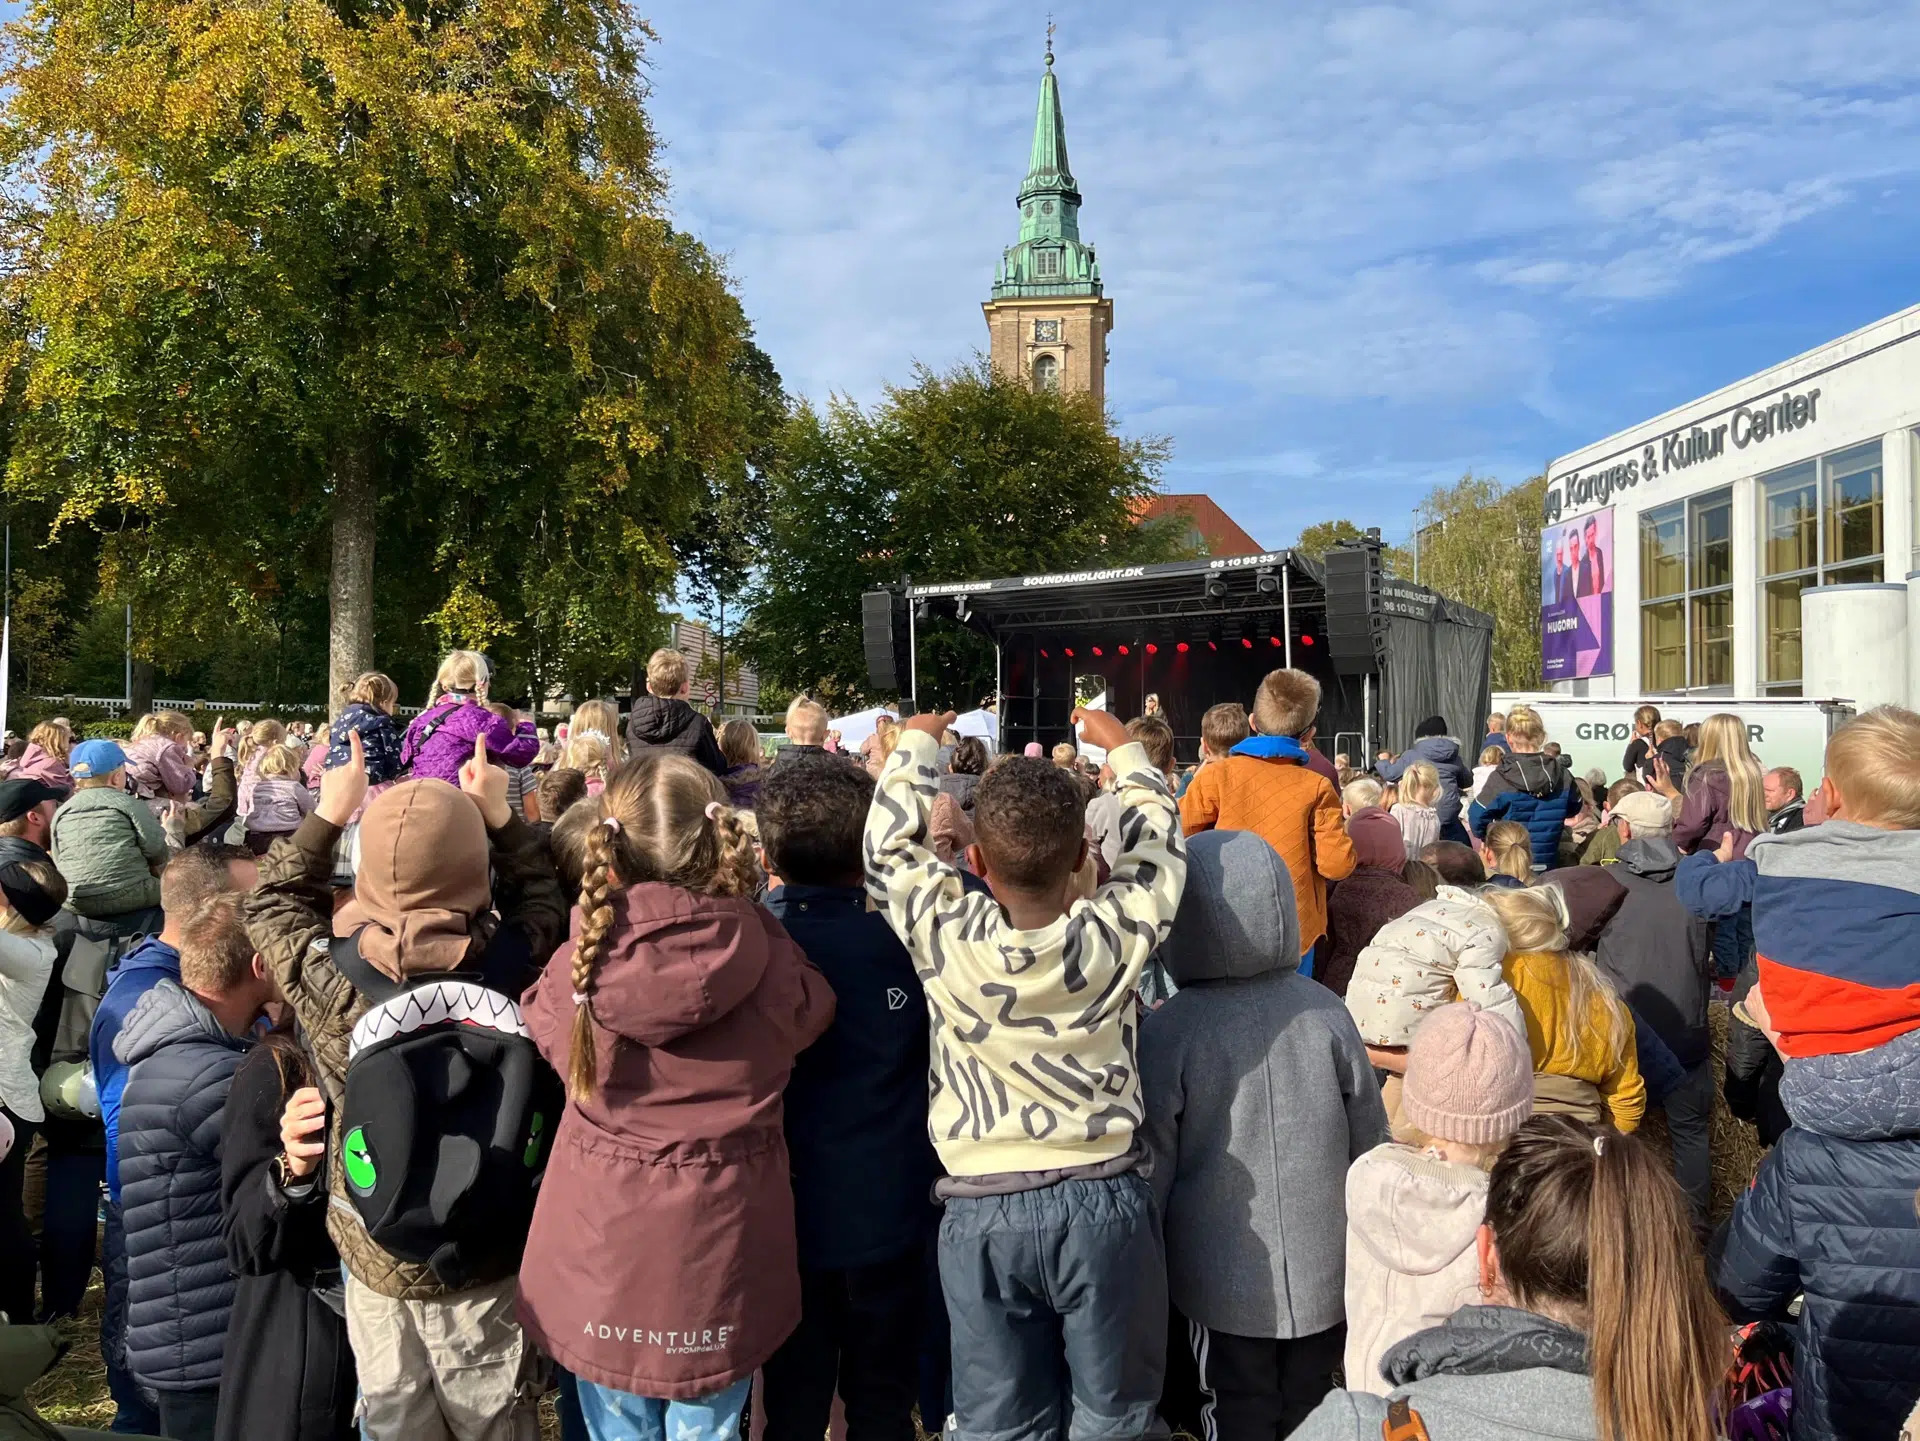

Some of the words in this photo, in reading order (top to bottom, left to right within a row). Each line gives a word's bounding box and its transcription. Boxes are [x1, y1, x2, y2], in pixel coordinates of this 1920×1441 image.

[1564, 459, 1638, 506] Kongres
[1641, 445, 1659, 482] &
[1662, 423, 1728, 474] Kultur
[1731, 388, 1821, 449] Center
[1227, 558, 1241, 567] 10
[1023, 567, 1144, 586] SOUNDANDLIGHT.DK
[1396, 603, 1406, 612] 10
[1547, 617, 1577, 633] HUGORM
[666, 1347, 678, 1355] BY
